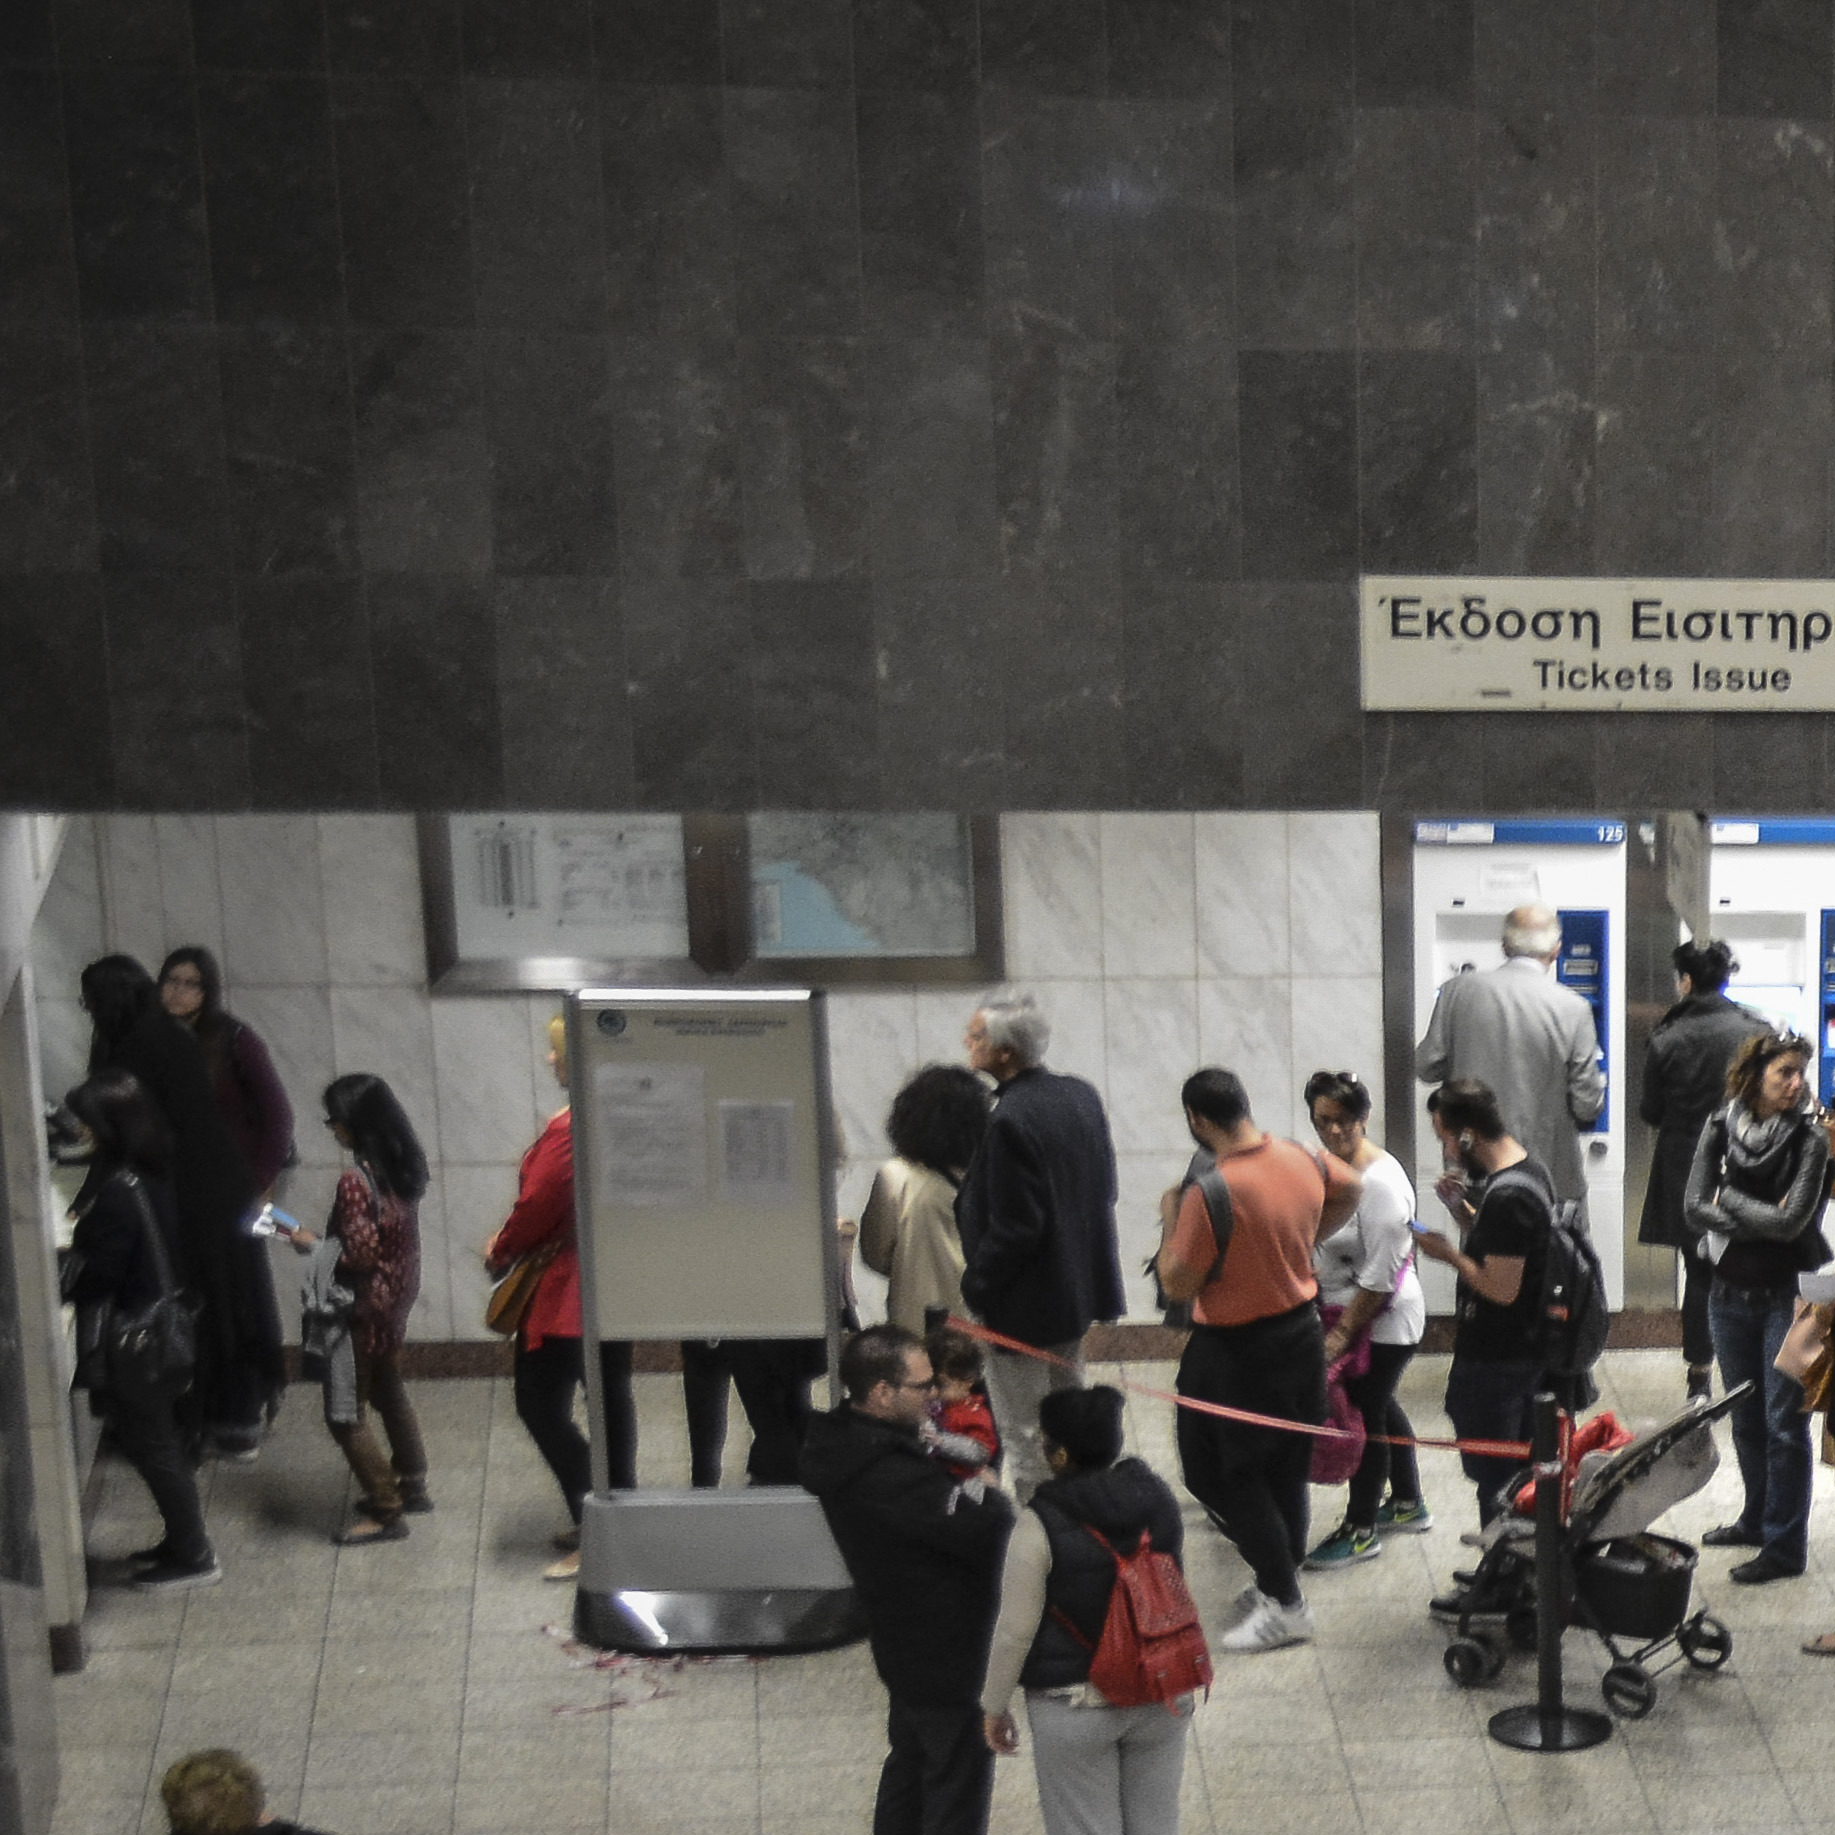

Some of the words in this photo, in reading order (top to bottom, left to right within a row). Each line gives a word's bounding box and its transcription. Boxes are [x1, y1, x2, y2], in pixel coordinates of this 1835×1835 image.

[1378, 596, 1601, 650] Έκδοση
[1533, 658, 1673, 691] Tickets
[1692, 660, 1792, 692] Issue
[1598, 825, 1623, 841] 125
